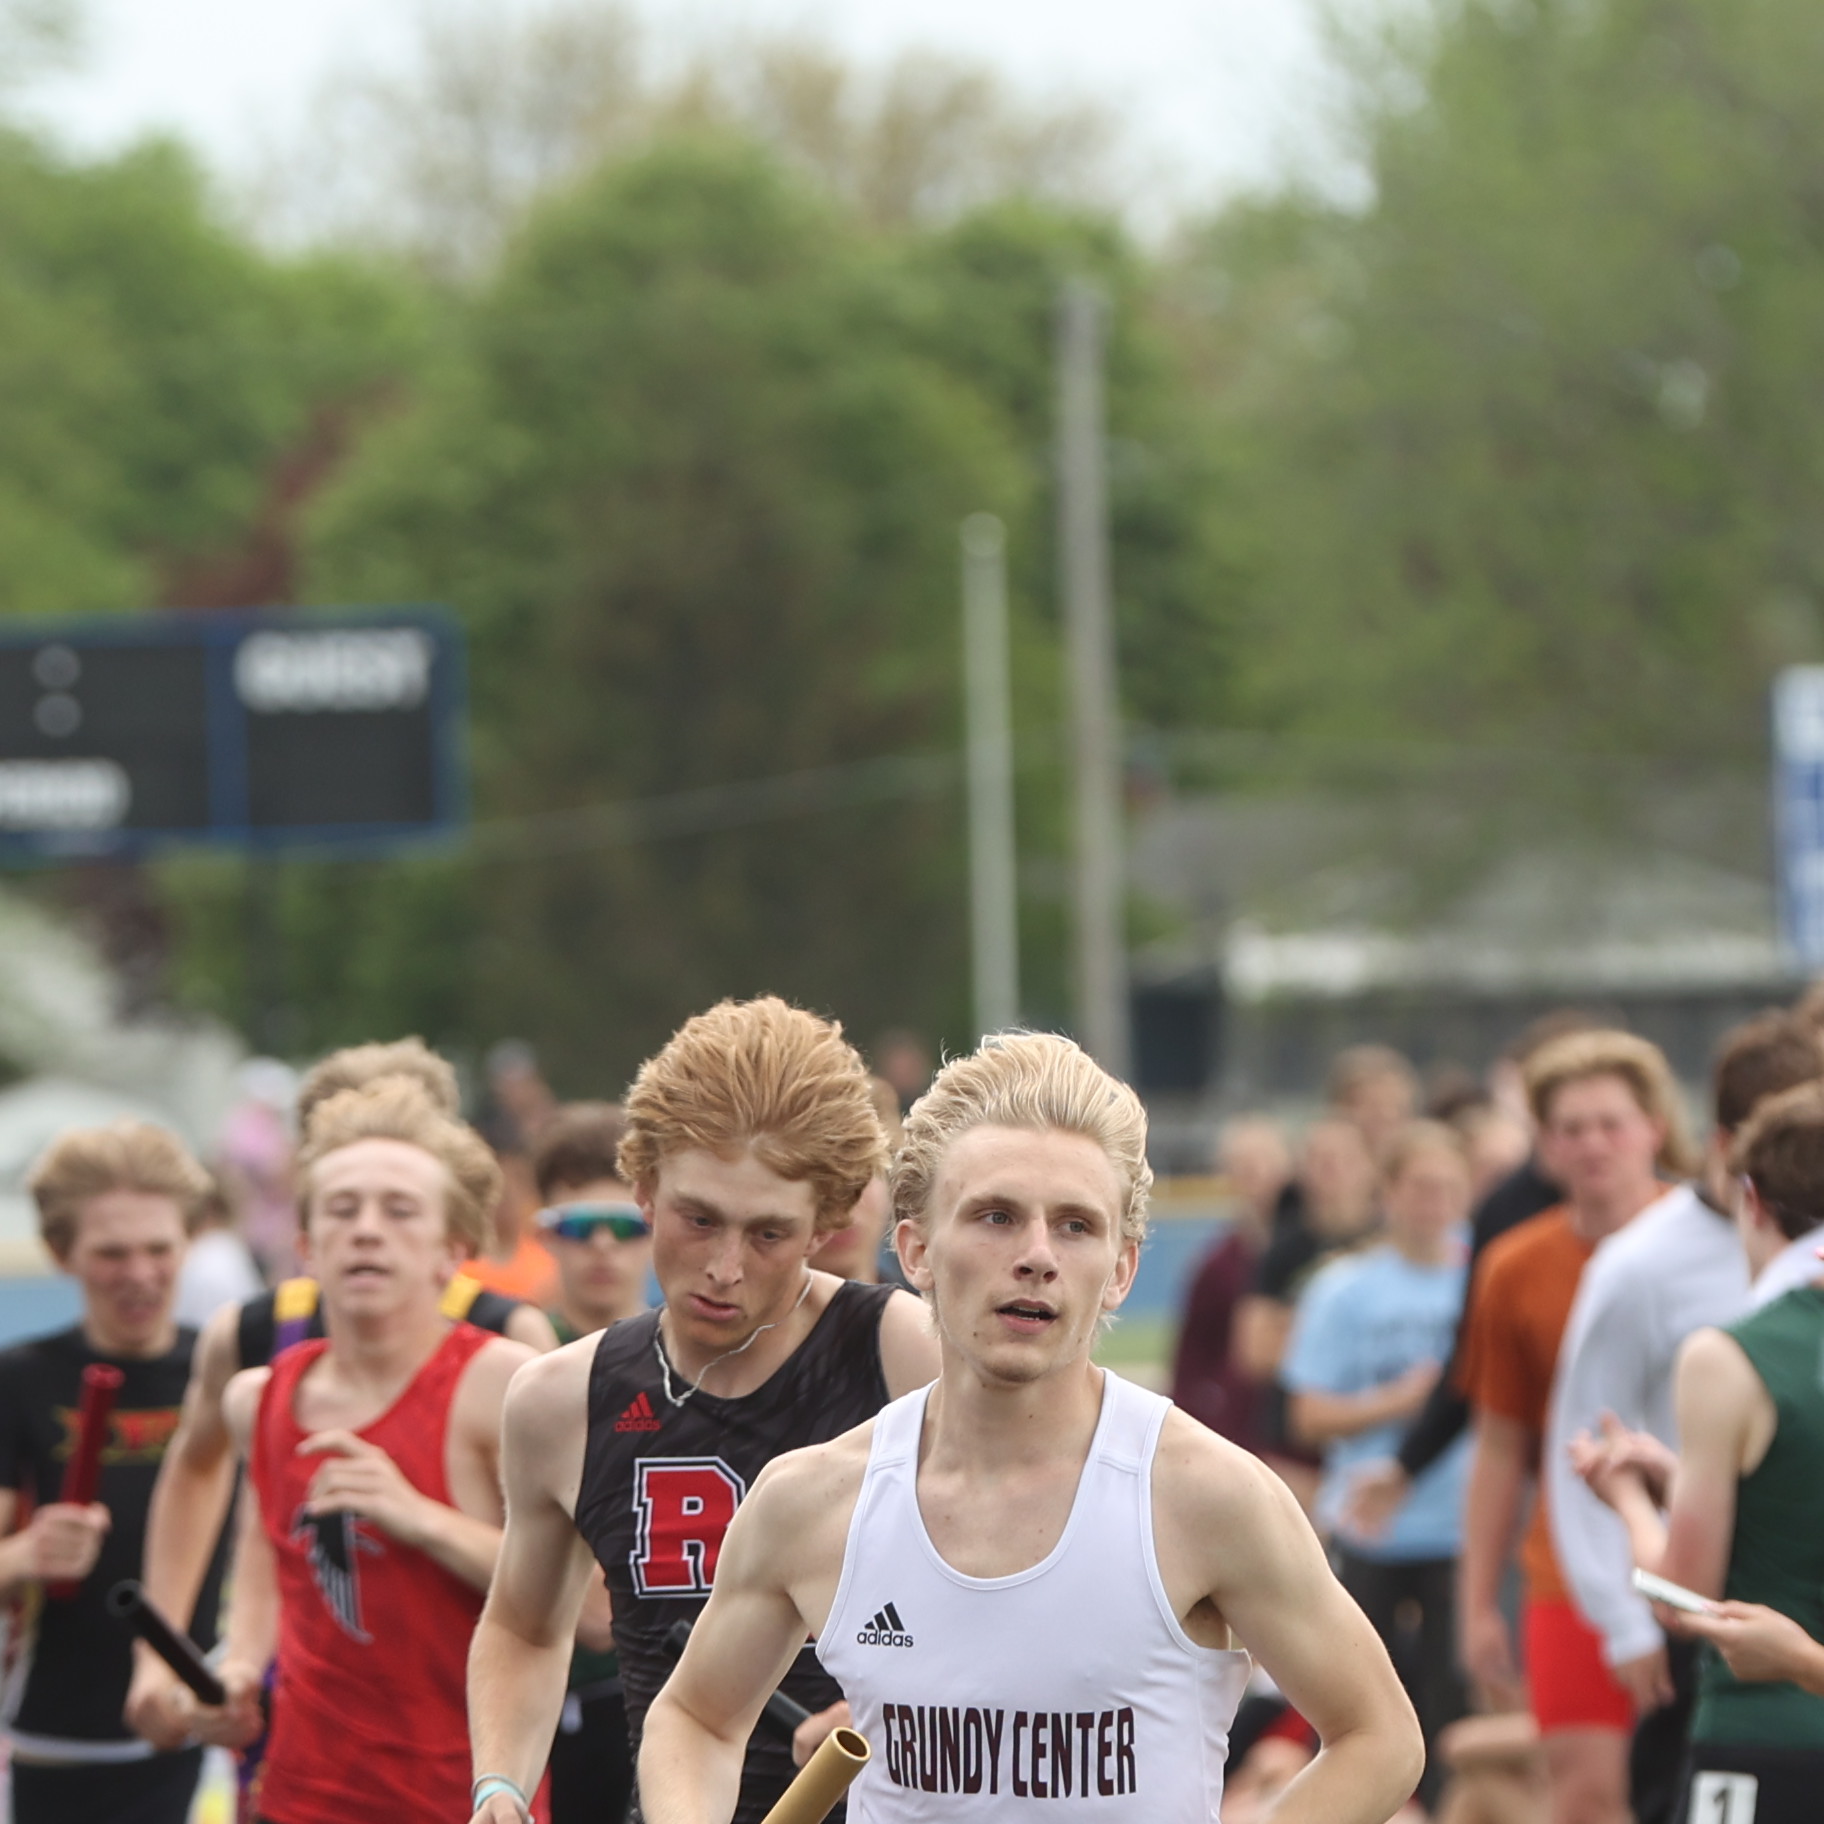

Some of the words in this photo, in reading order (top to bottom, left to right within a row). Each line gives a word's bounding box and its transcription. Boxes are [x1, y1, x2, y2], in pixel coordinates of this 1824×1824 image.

[613, 1418, 661, 1432] adidas
[629, 1456, 745, 1599] R
[857, 1629, 914, 1648] adidas
[882, 1703, 1004, 1794] GRUNDY
[1012, 1706, 1136, 1799] CENTER
